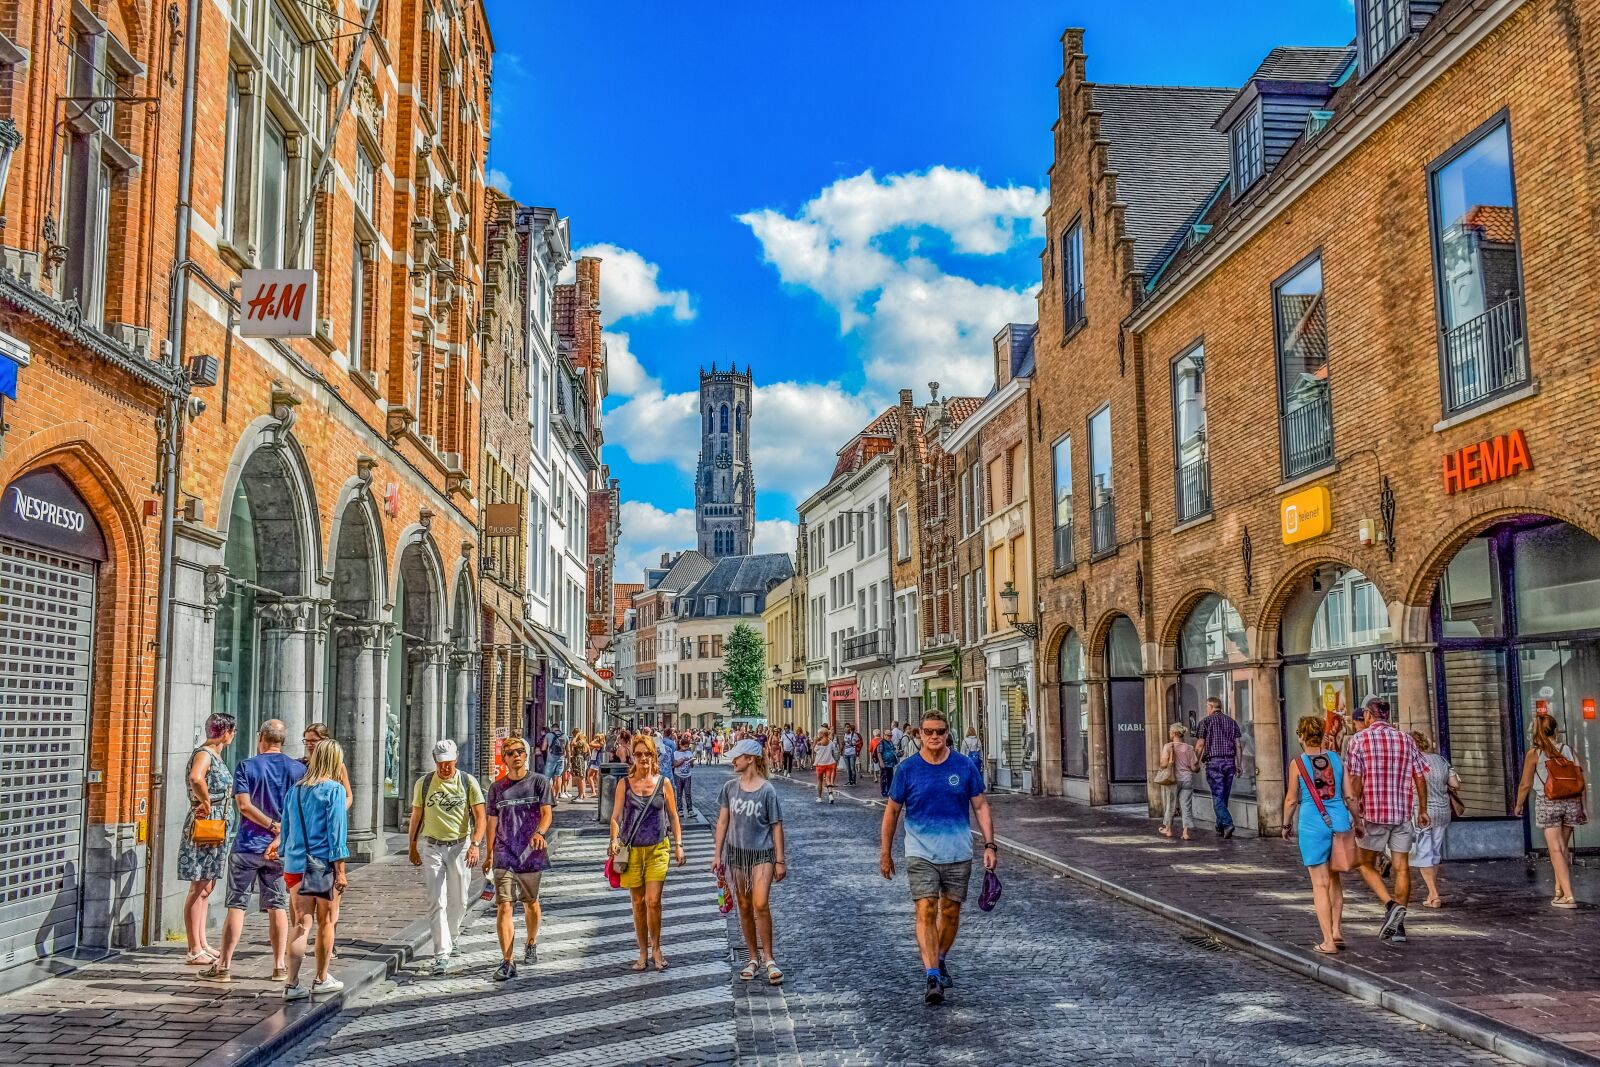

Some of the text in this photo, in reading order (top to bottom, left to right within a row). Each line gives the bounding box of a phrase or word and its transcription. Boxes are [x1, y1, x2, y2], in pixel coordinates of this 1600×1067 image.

[248, 283, 307, 321] H&M
[1442, 429, 1534, 496] HEMA
[10, 486, 84, 532] NESPRESSO
